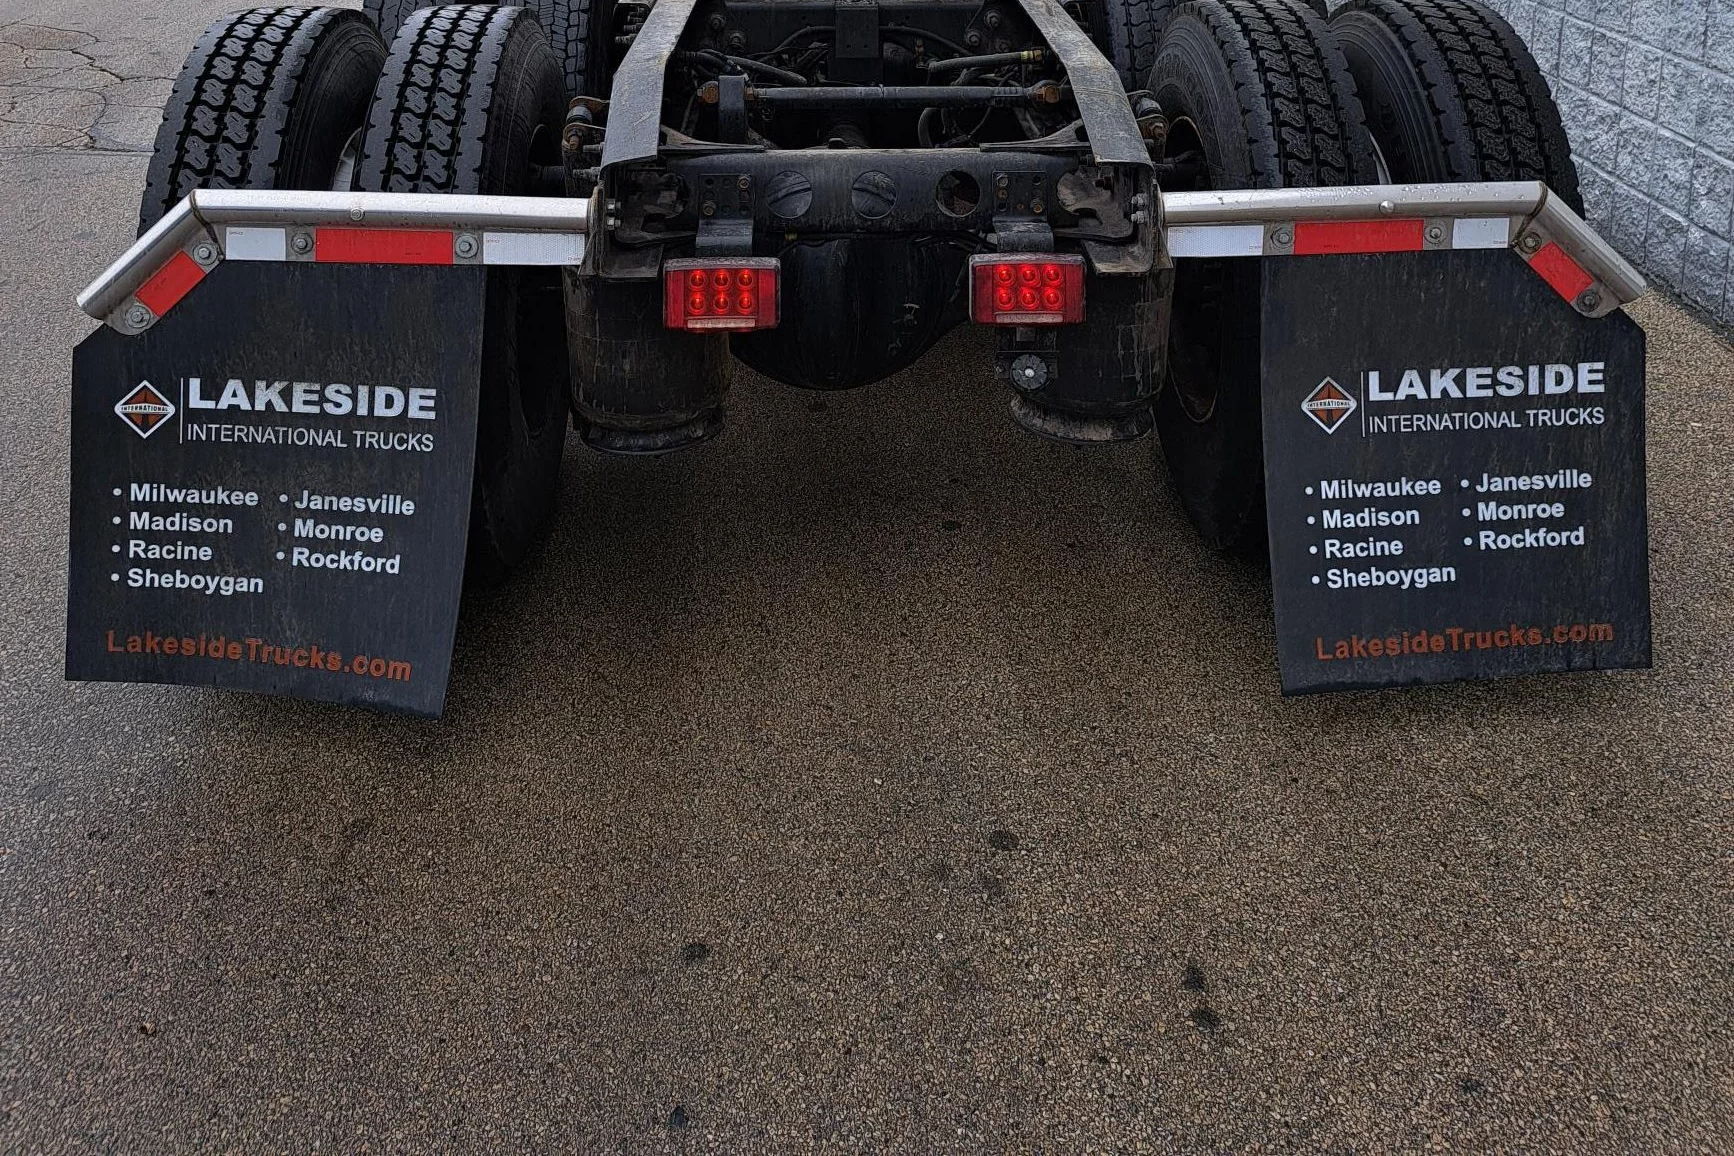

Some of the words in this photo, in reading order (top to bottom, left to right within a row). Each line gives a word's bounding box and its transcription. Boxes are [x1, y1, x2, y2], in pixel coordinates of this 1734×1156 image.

[1368, 361, 1605, 402] LAKESIDE
[120, 404, 170, 412] INTERNATIONAL
[188, 377, 437, 420] LAKESIDE
[1369, 410, 1522, 433] INTERNATIONAL
[1525, 406, 1605, 427] TRUCKS
[187, 423, 348, 448] INTERNATIONAL
[352, 430, 434, 452] TRUCKS
[1320, 476, 1442, 500] Milwaukee
[1475, 469, 1592, 493] Janesville
[130, 483, 259, 506] Milwaukee
[294, 489, 415, 516] Janesville
[129, 511, 233, 534] Madison
[1322, 507, 1420, 529] Madison
[1477, 501, 1565, 522] Monroe
[294, 518, 384, 543] Monroe
[1479, 525, 1585, 551] Rockford
[129, 539, 213, 561] Racine
[1324, 536, 1404, 559] Racine
[292, 546, 401, 575] Rockford
[127, 567, 264, 596] Sheboygan
[1327, 566, 1456, 590] Sheboygan
[1315, 623, 1614, 661] LakesideTrucks.com
[105, 630, 412, 681] LakesideTrucks.com
